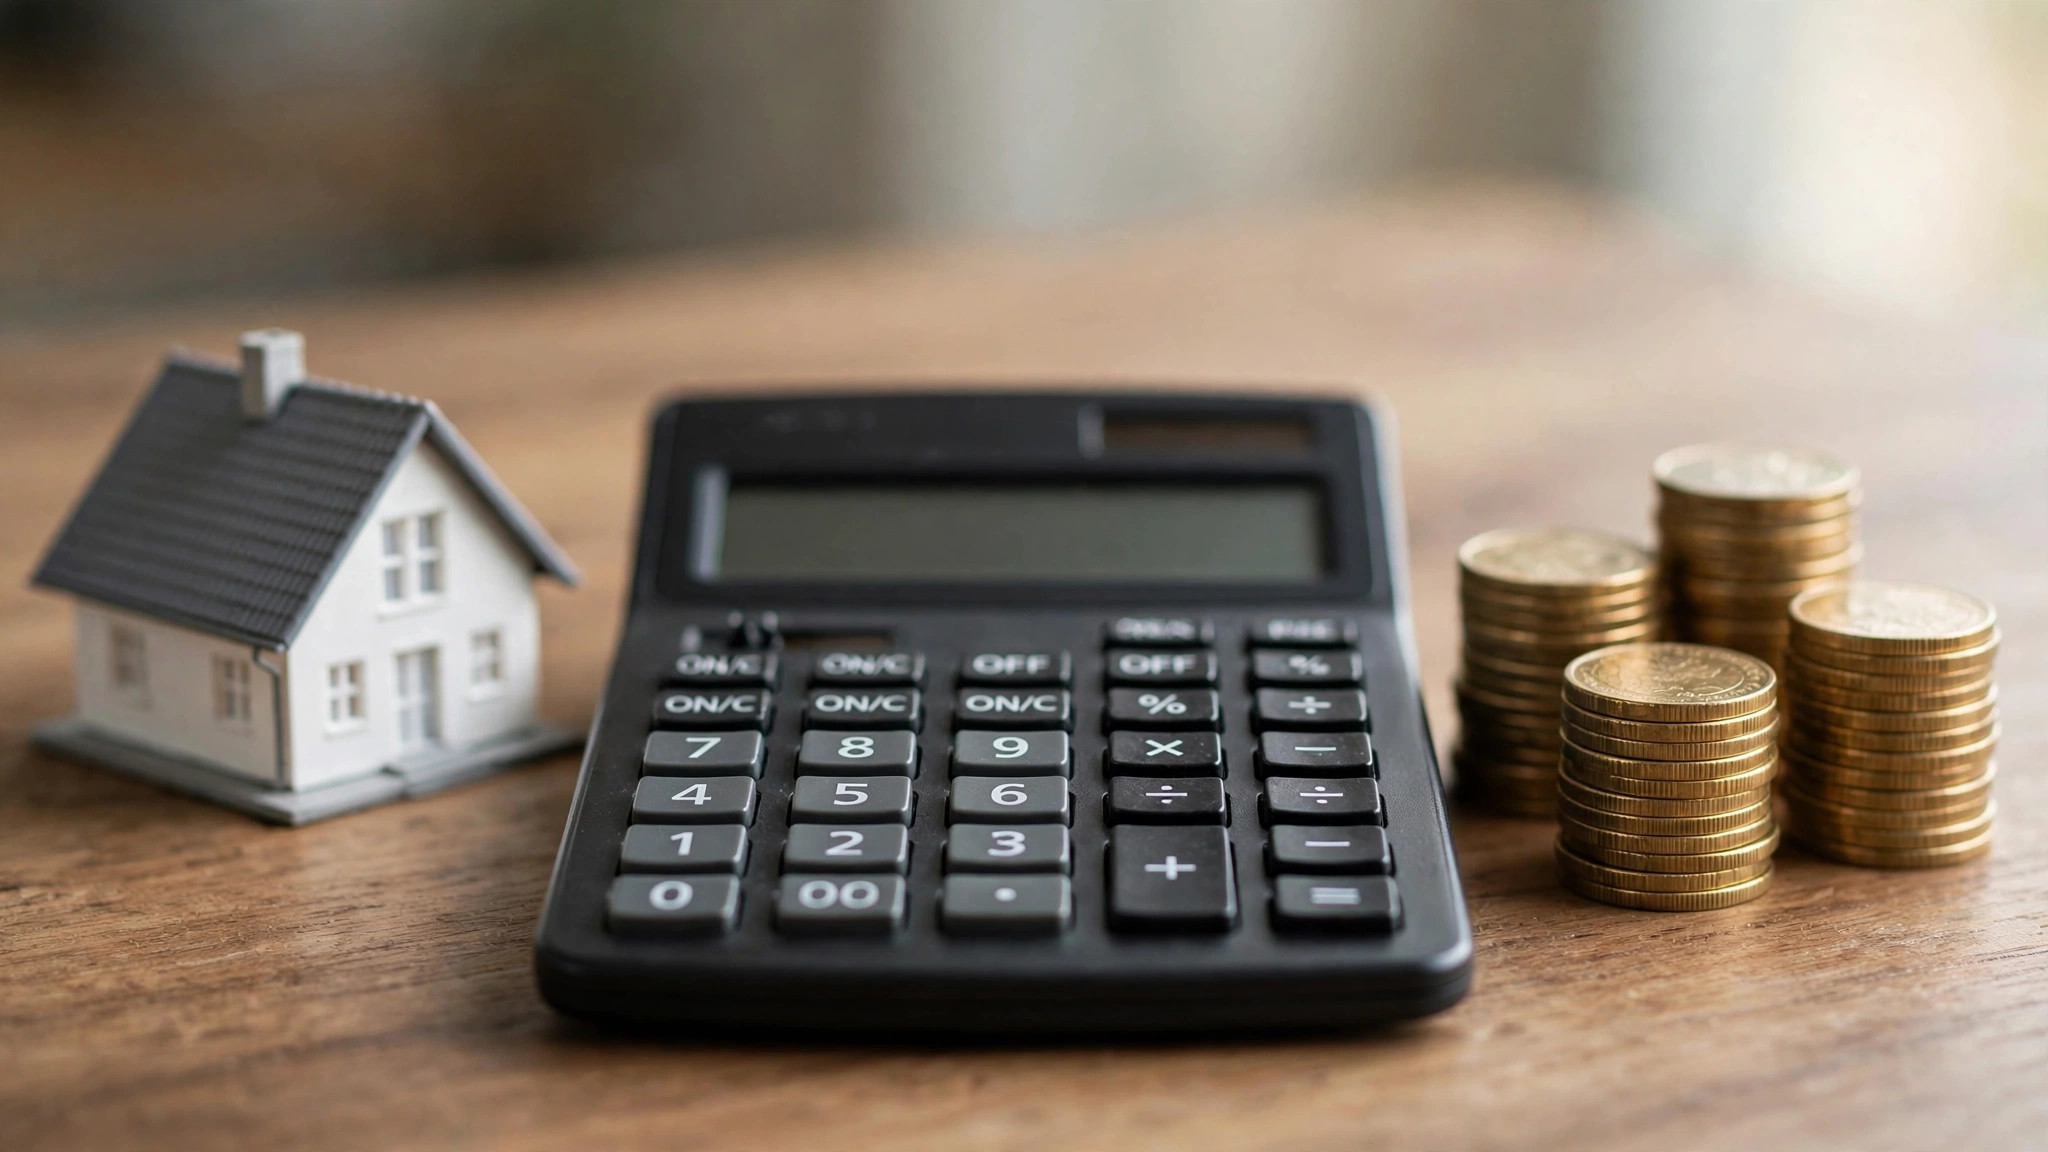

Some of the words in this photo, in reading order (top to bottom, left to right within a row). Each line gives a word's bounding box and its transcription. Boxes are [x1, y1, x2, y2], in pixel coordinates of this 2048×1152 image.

[972, 654, 1051, 675] OFF
[1118, 654, 1196, 675] OFF
[665, 695, 757, 713] ON/C
[815, 694, 907, 712] ON/C
[965, 694, 1058, 712] ON/C
[686, 737, 721, 759] 7
[838, 736, 874, 759] 8
[992, 736, 1029, 759] 9
[671, 783, 712, 806] 4
[833, 783, 868, 806] 5
[990, 783, 1028, 806] 6
[670, 831, 694, 856] 1
[825, 831, 864, 856] 2
[988, 830, 1027, 857] 3
[799, 880, 880, 910] 00
